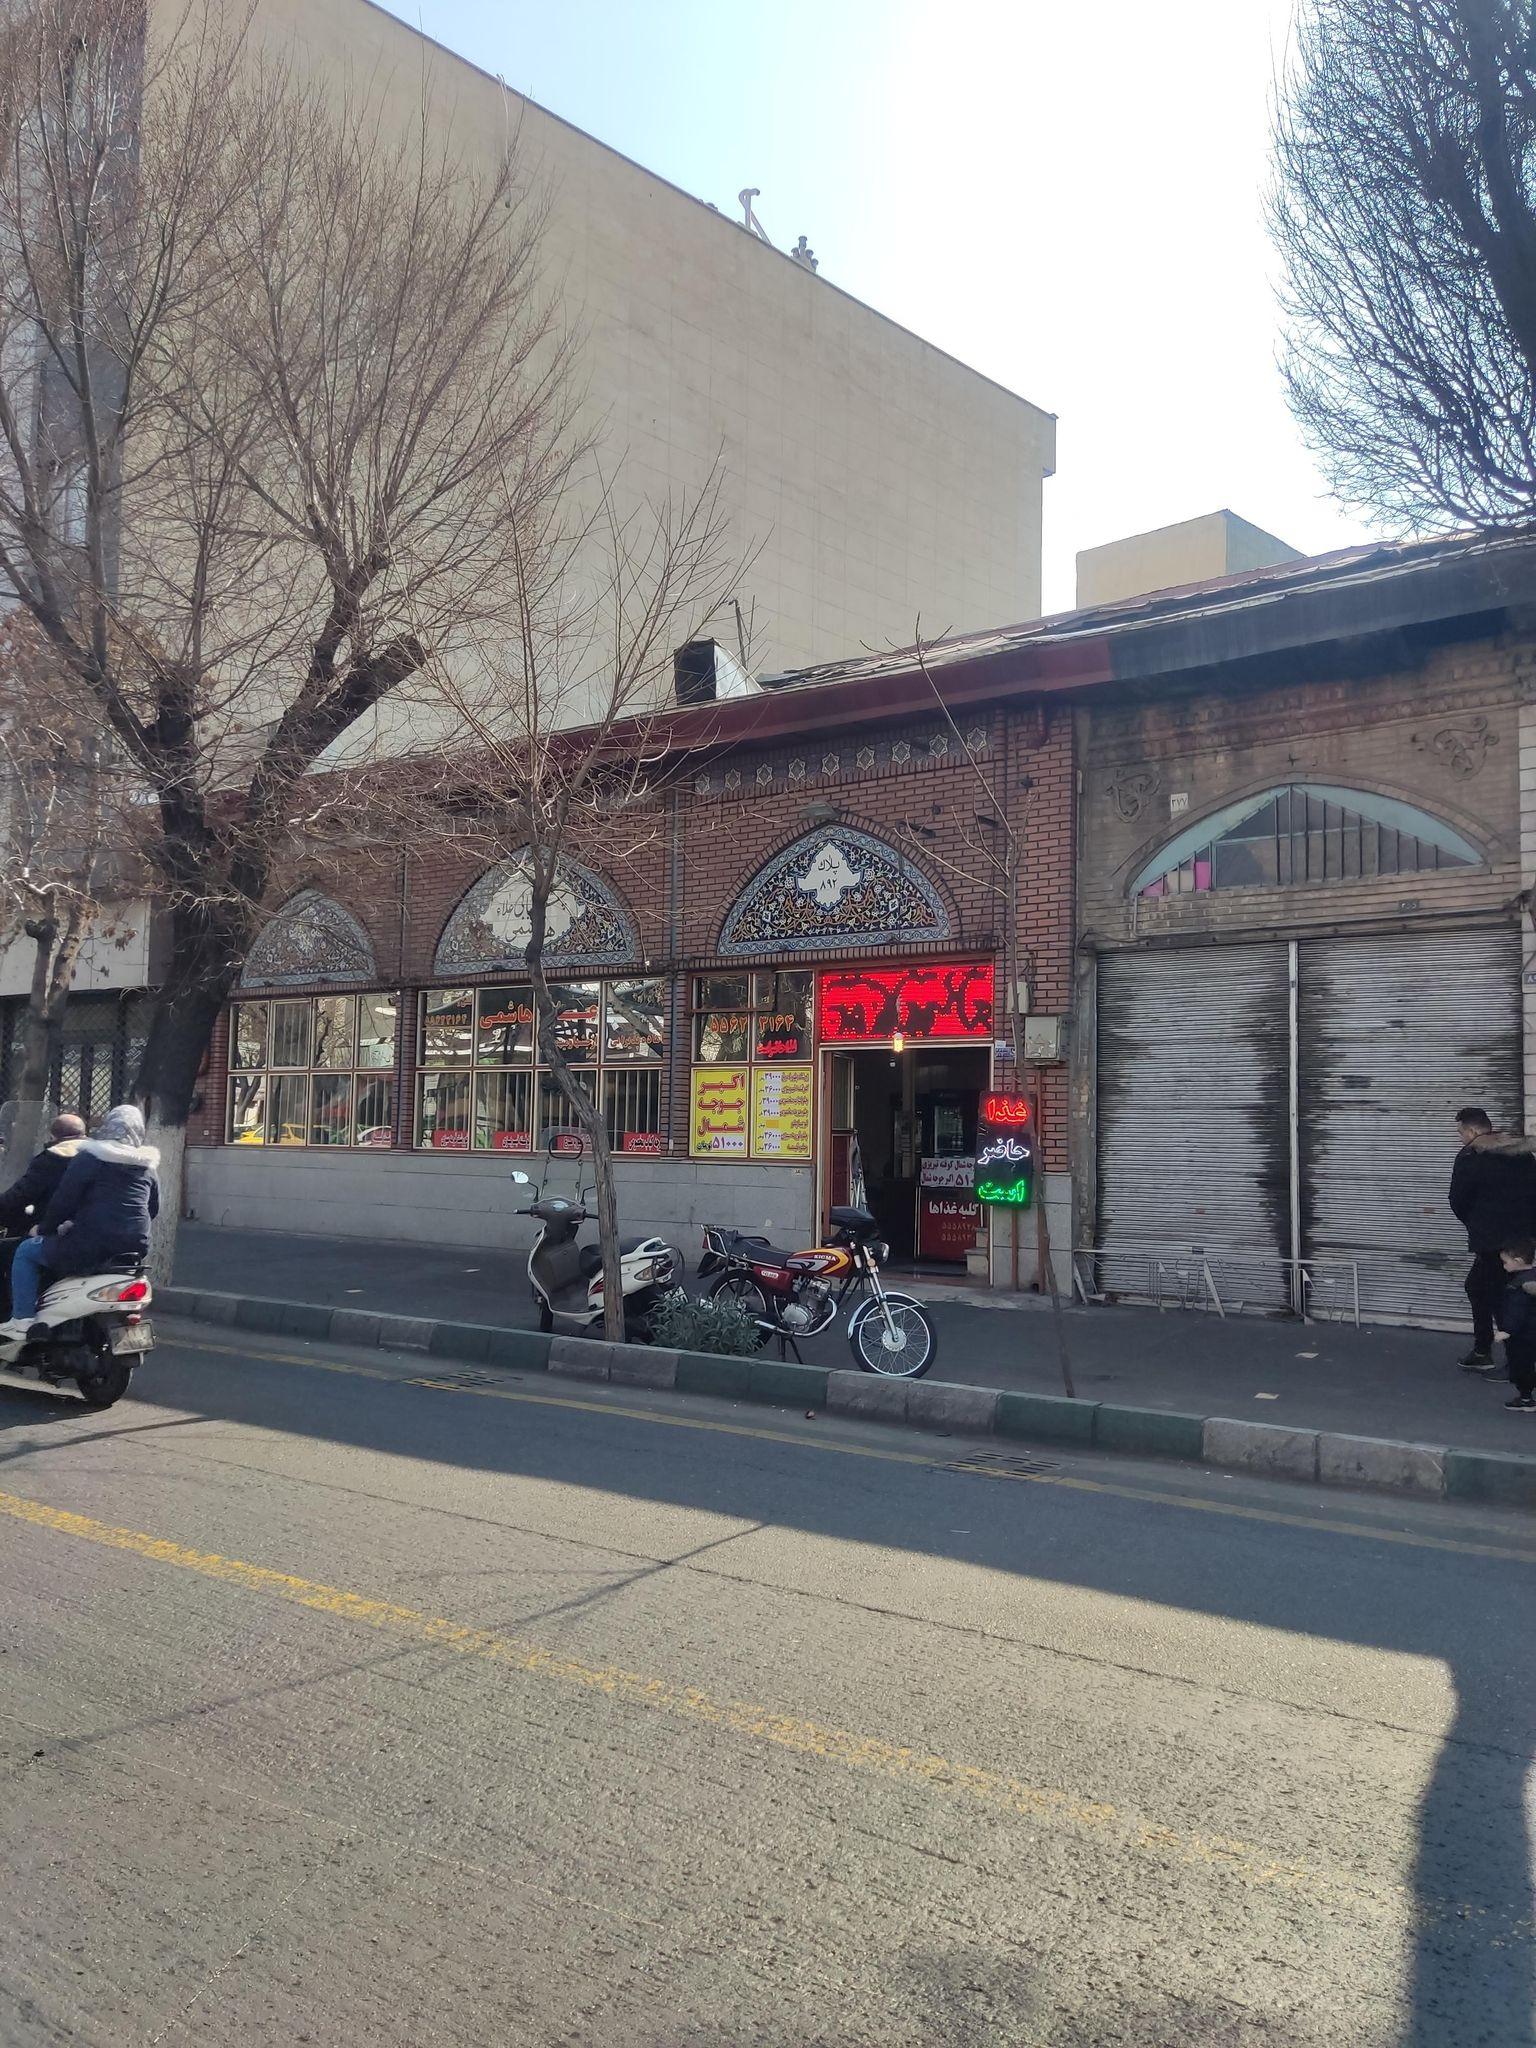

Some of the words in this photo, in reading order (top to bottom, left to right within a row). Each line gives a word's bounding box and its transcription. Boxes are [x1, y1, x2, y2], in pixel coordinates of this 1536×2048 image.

[820, 878, 837, 890] ۸۹۲
[479, 1001, 534, 1029] هاشمی
[698, 1073, 745, 1095] اکبر
[698, 1097, 745, 1114] جوجه
[987, 1099, 1028, 1122] غذا
[698, 1115, 745, 1137] شمال
[977, 1138, 1030, 1164] حاضر
[979, 1179, 1025, 1202] است
[929, 1201, 958, 1215] غذاها
